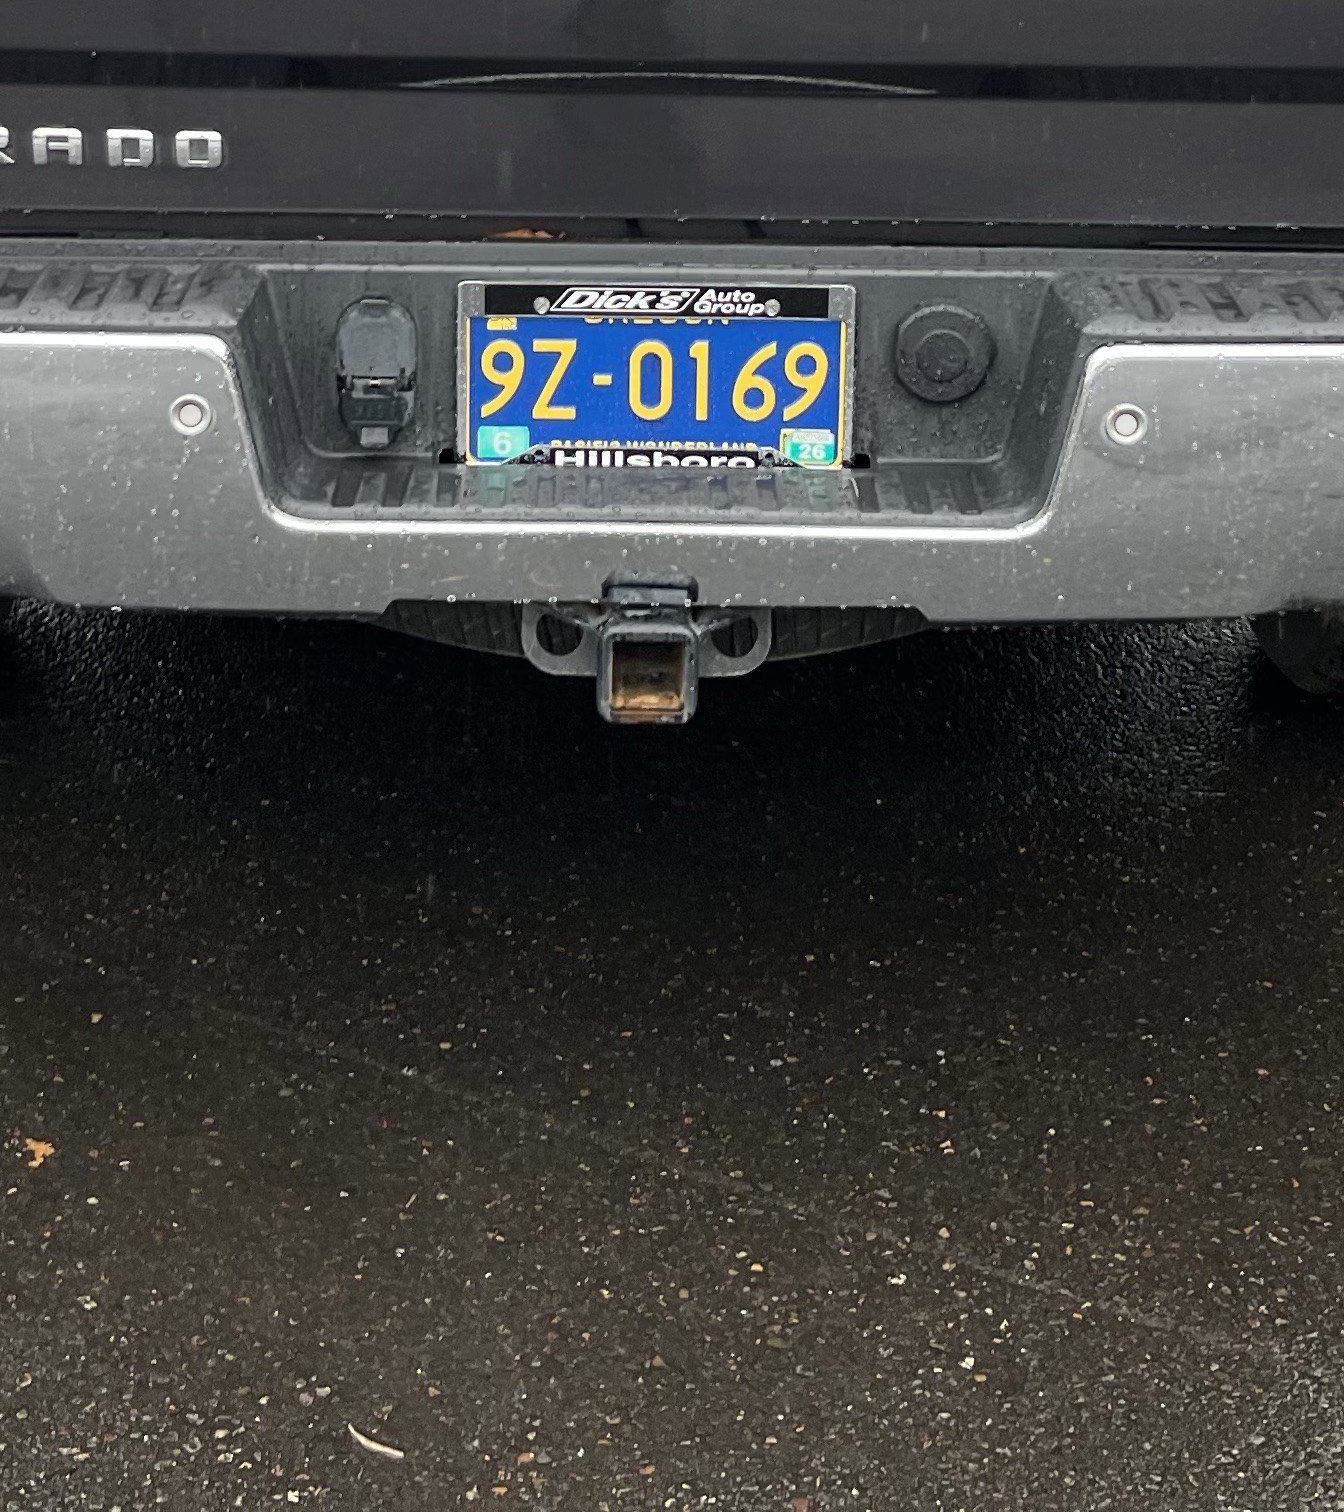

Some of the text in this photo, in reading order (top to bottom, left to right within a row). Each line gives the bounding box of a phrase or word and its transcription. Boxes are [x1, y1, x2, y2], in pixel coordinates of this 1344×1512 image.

[561, 290, 683, 310] Dick's
[699, 289, 756, 302] Auto
[693, 301, 765, 316] Group
[481, 338, 829, 422] 9Z-0169
[493, 431, 513, 455] 6
[799, 444, 826, 460] 26
[554, 450, 756, 468] Hillsboro
